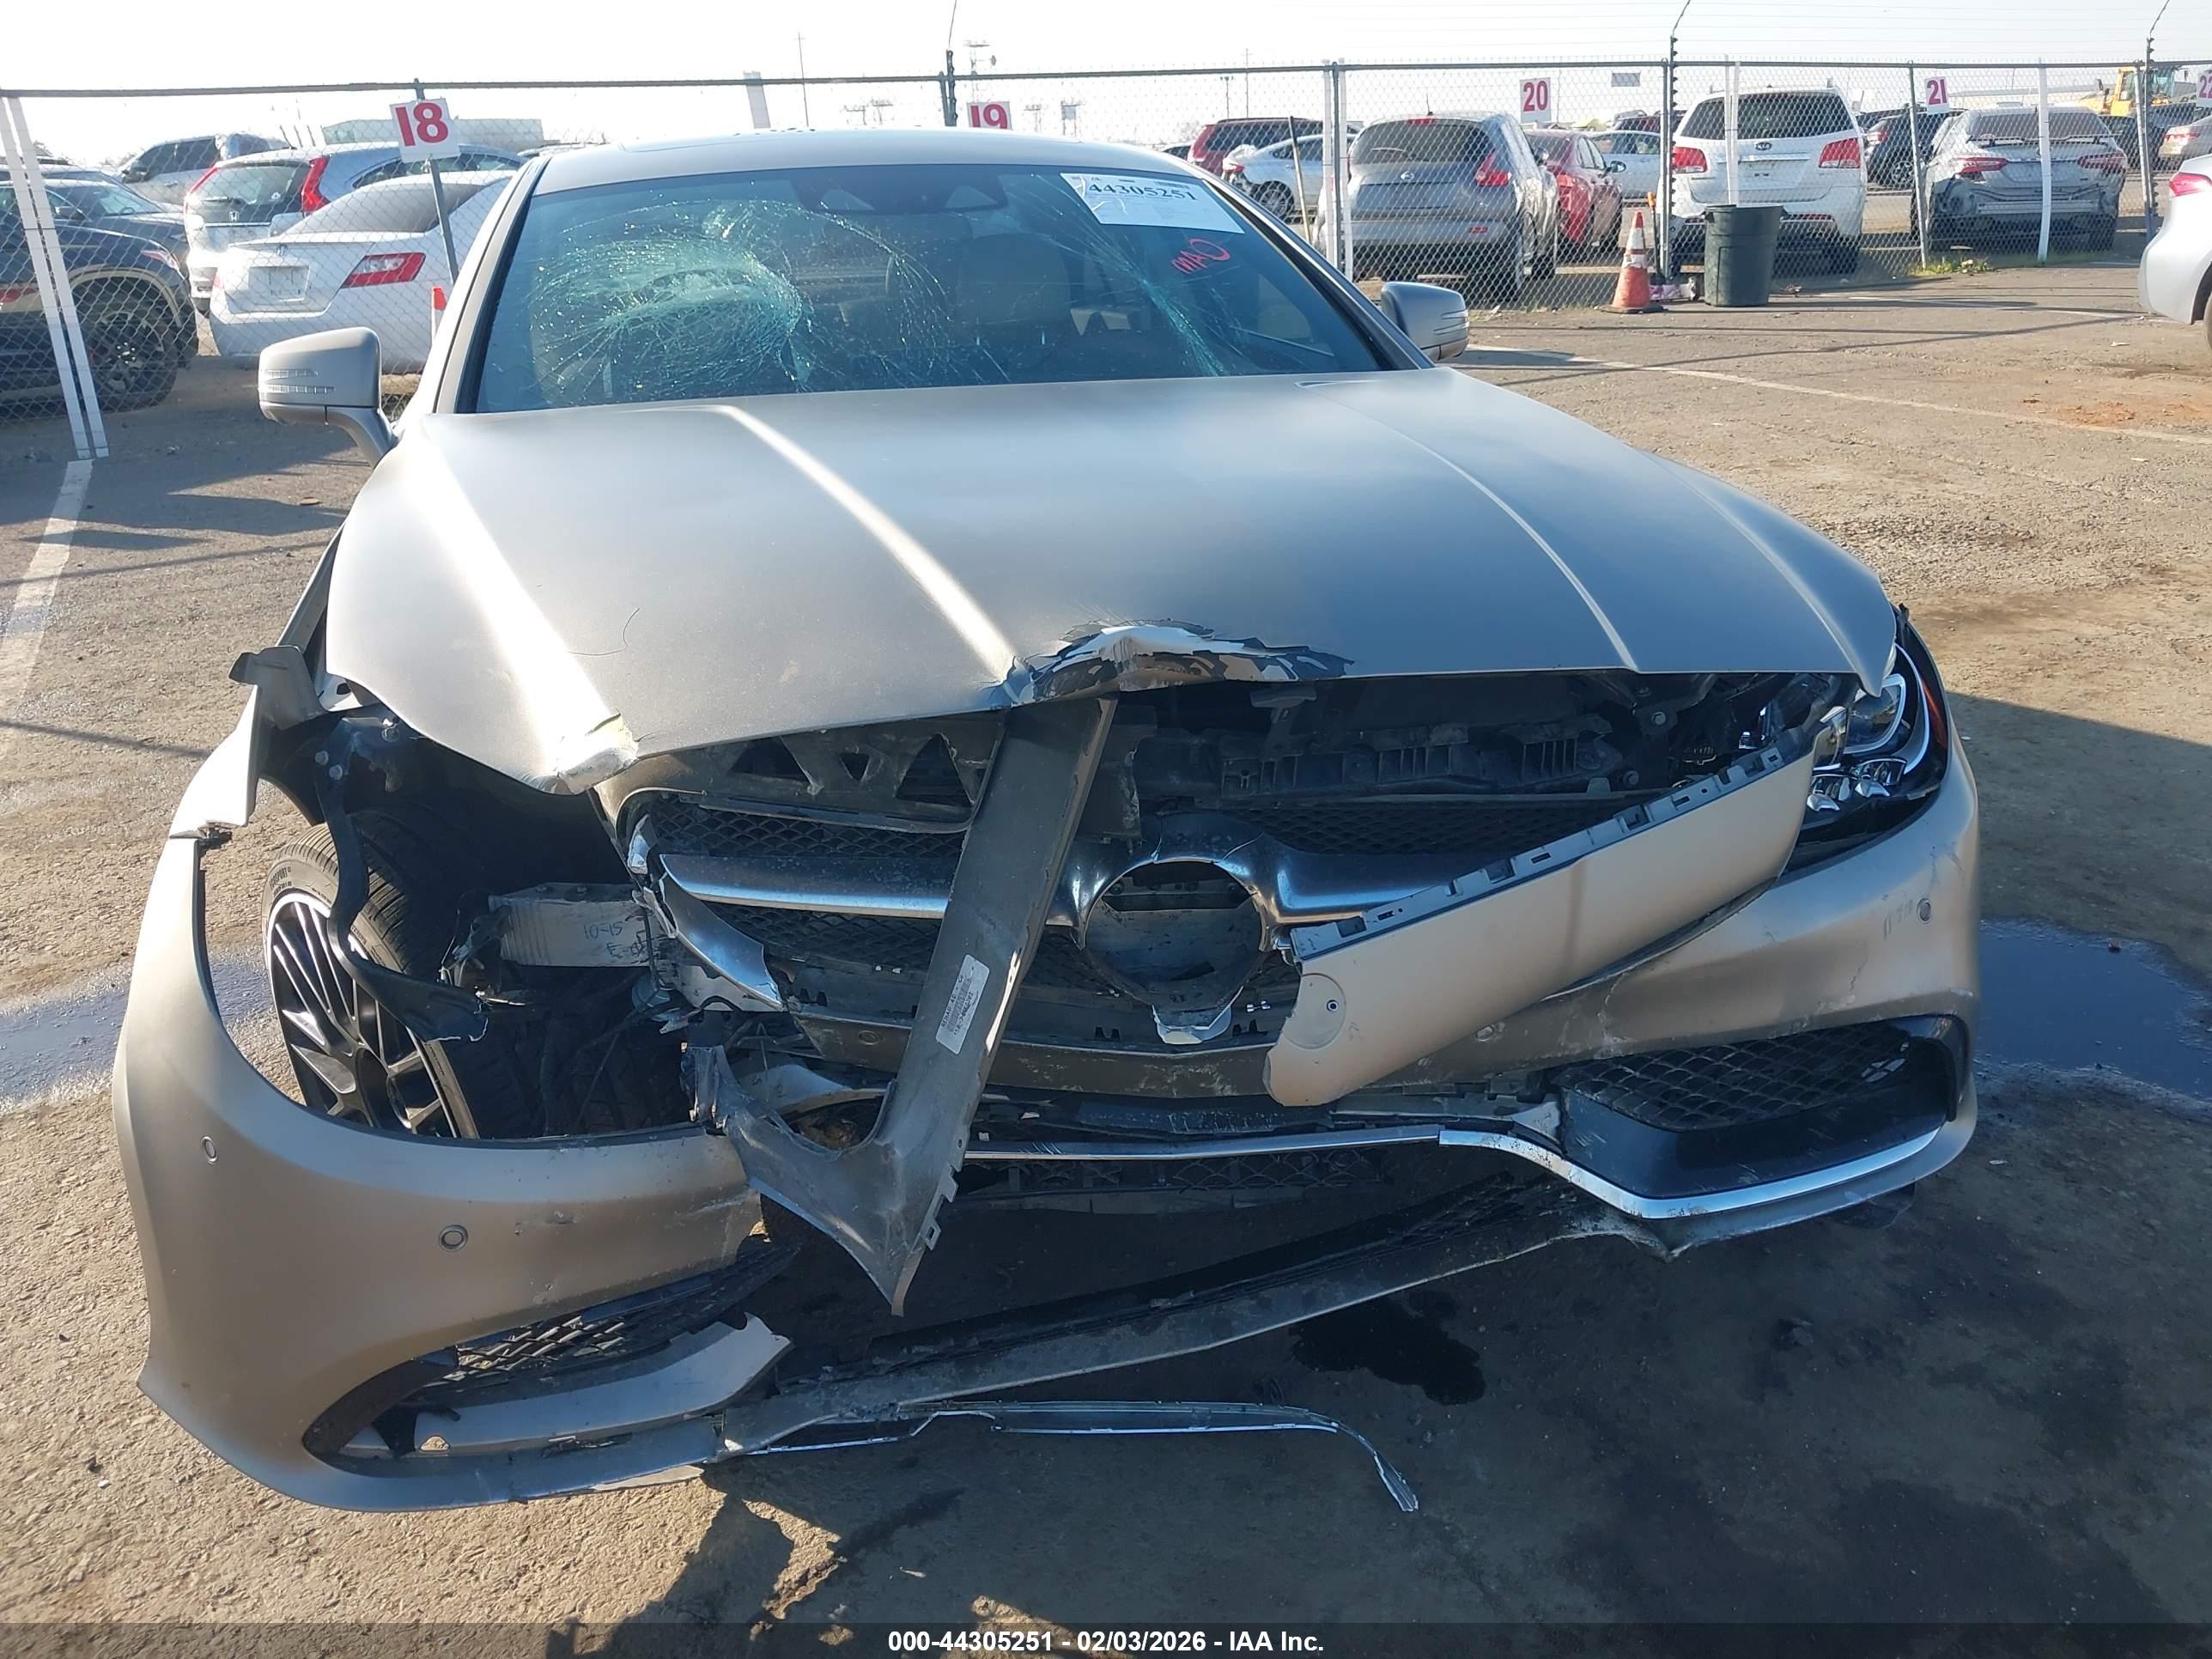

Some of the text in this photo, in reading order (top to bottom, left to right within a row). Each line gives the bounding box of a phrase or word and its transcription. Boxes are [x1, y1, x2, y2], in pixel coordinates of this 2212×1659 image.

[1523, 80, 1548, 112] 20
[1926, 79, 1948, 105] 21
[395, 102, 449, 147] 18
[970, 103, 1008, 129] 19
[1089, 183, 1198, 200] 44305251
